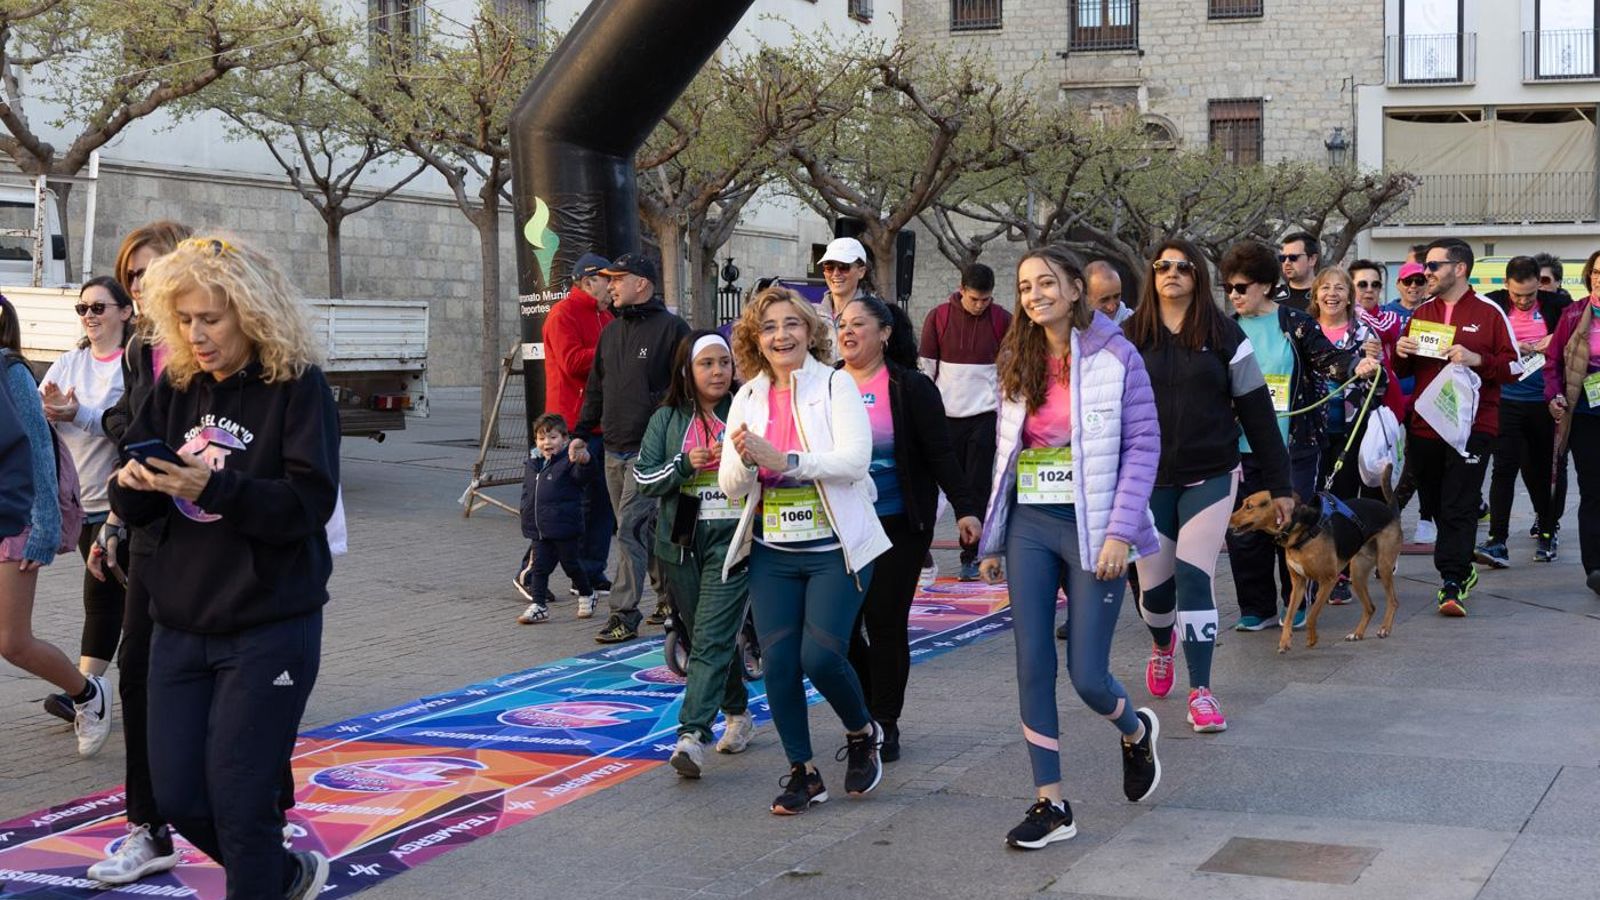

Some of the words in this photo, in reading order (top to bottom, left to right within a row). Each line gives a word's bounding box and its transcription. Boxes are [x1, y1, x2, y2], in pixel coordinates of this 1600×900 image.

[1420, 335, 1440, 345] 1051
[205, 414, 216, 426] EL
[218, 417, 254, 444] CAMIO
[1038, 470, 1073, 482] 1024
[698, 490, 728, 501] 1044
[781, 510, 813, 522] 1060
[542, 761, 633, 797] TEAMERGY
[30, 791, 127, 828] EAMERGY
[389, 815, 498, 858] TEAMERGY
